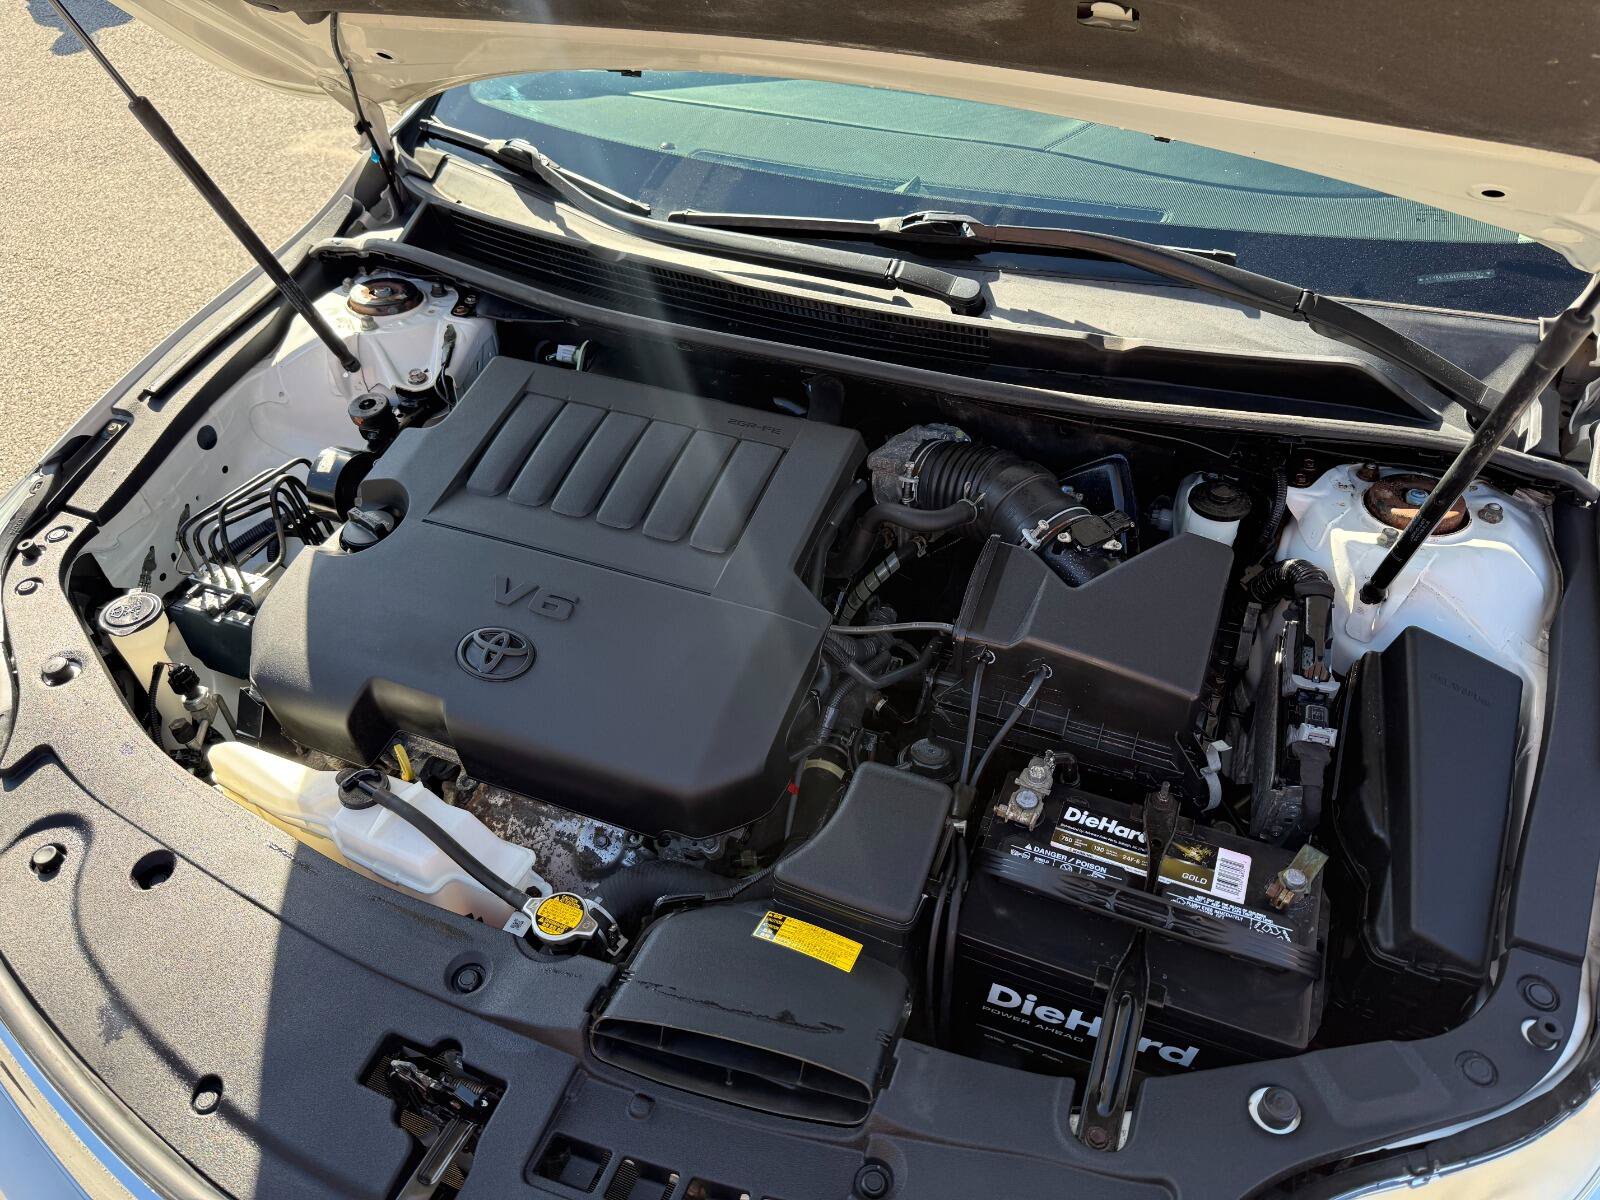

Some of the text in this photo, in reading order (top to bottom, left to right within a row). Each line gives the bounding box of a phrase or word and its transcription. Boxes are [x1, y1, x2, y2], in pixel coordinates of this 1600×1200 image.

[494, 575, 580, 621] V6
[1033, 846, 1068, 861] DANGER
[1075, 859, 1107, 873] POISON
[1181, 872, 1208, 885] GOLD
[982, 1005, 1084, 1044] POWER AHEAD
[986, 982, 1200, 1067] DieHrd
